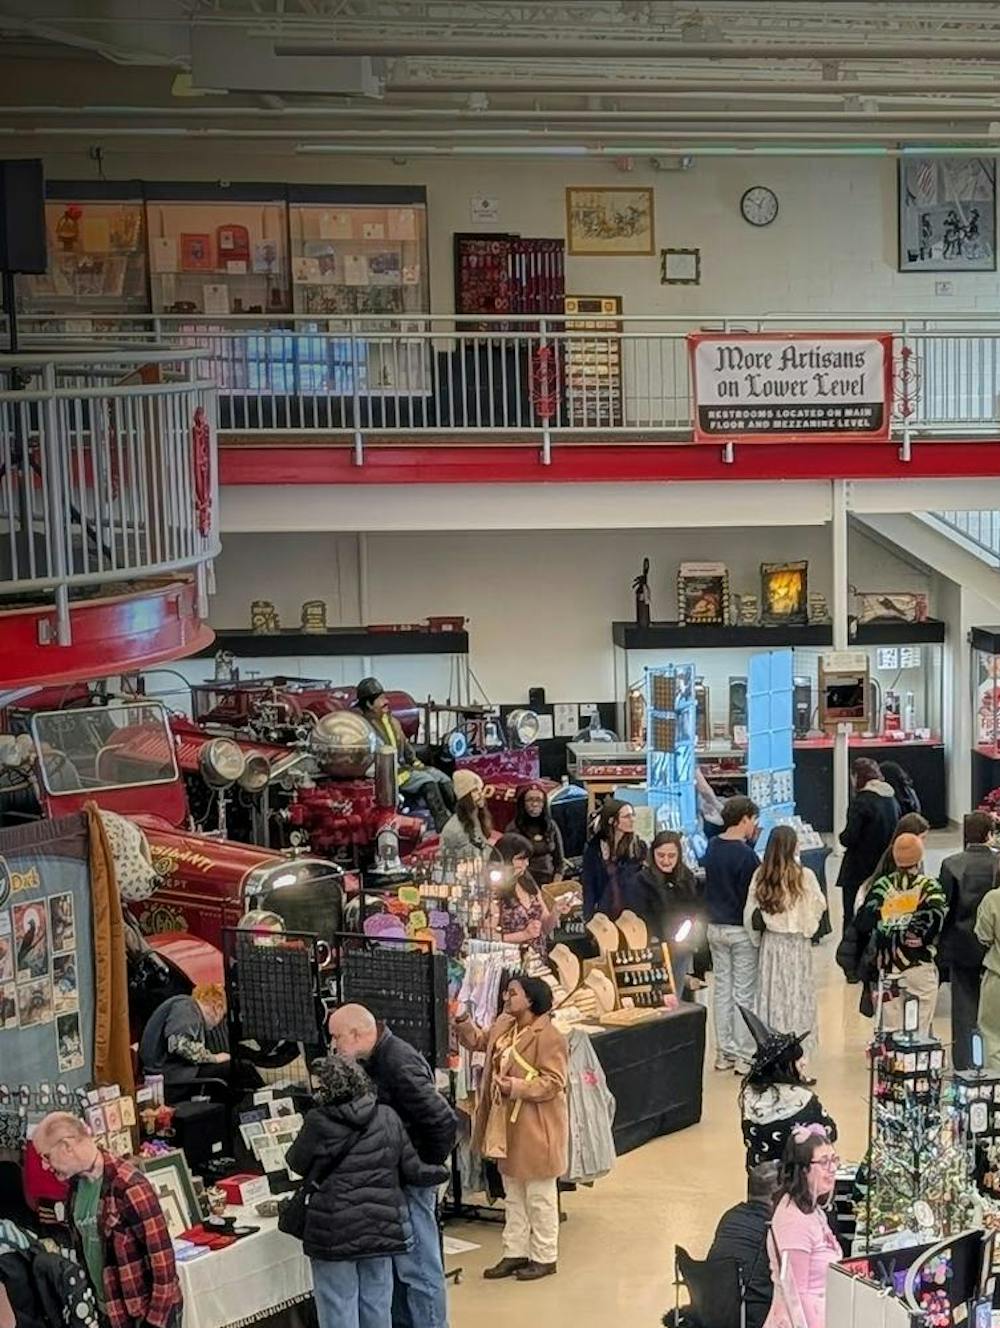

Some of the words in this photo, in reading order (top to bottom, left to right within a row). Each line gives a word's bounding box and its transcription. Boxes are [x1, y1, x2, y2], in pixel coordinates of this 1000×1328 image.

[715, 345, 773, 372] More
[778, 345, 866, 372] Artisans
[717, 380, 740, 398] on
[744, 373, 808, 398] Lower
[812, 372, 866, 397] Level
[708, 409, 774, 419] RESTROOMS
[776, 408, 824, 418] LOCATED
[827, 408, 842, 417] ON
[844, 407, 872, 417] MAIN
[710, 420, 746, 429] FLOOR
[748, 420, 770, 429] AND
[772, 419, 835, 428] MEZZANINE
[837, 419, 871, 428] LEVEL
